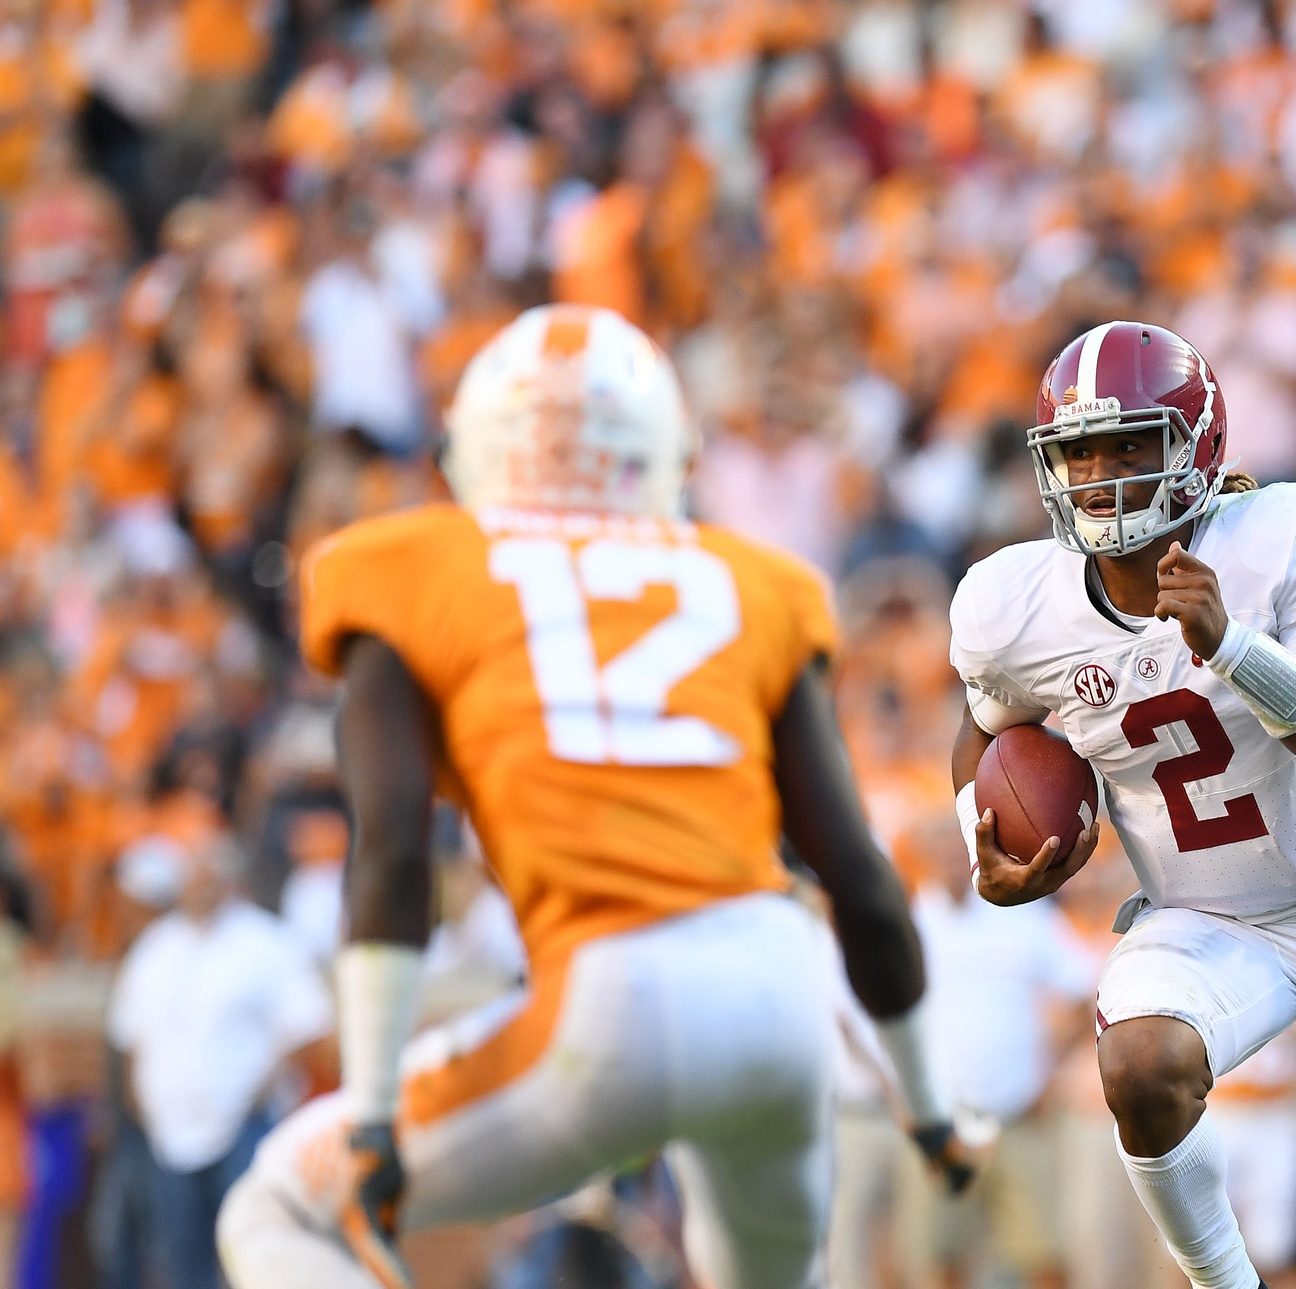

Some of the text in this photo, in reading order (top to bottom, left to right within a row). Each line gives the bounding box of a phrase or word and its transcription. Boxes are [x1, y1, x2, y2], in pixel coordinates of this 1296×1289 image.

[487, 535, 745, 767] 12
[1075, 665, 1115, 706] SEC
[1120, 687, 1270, 854] 2
